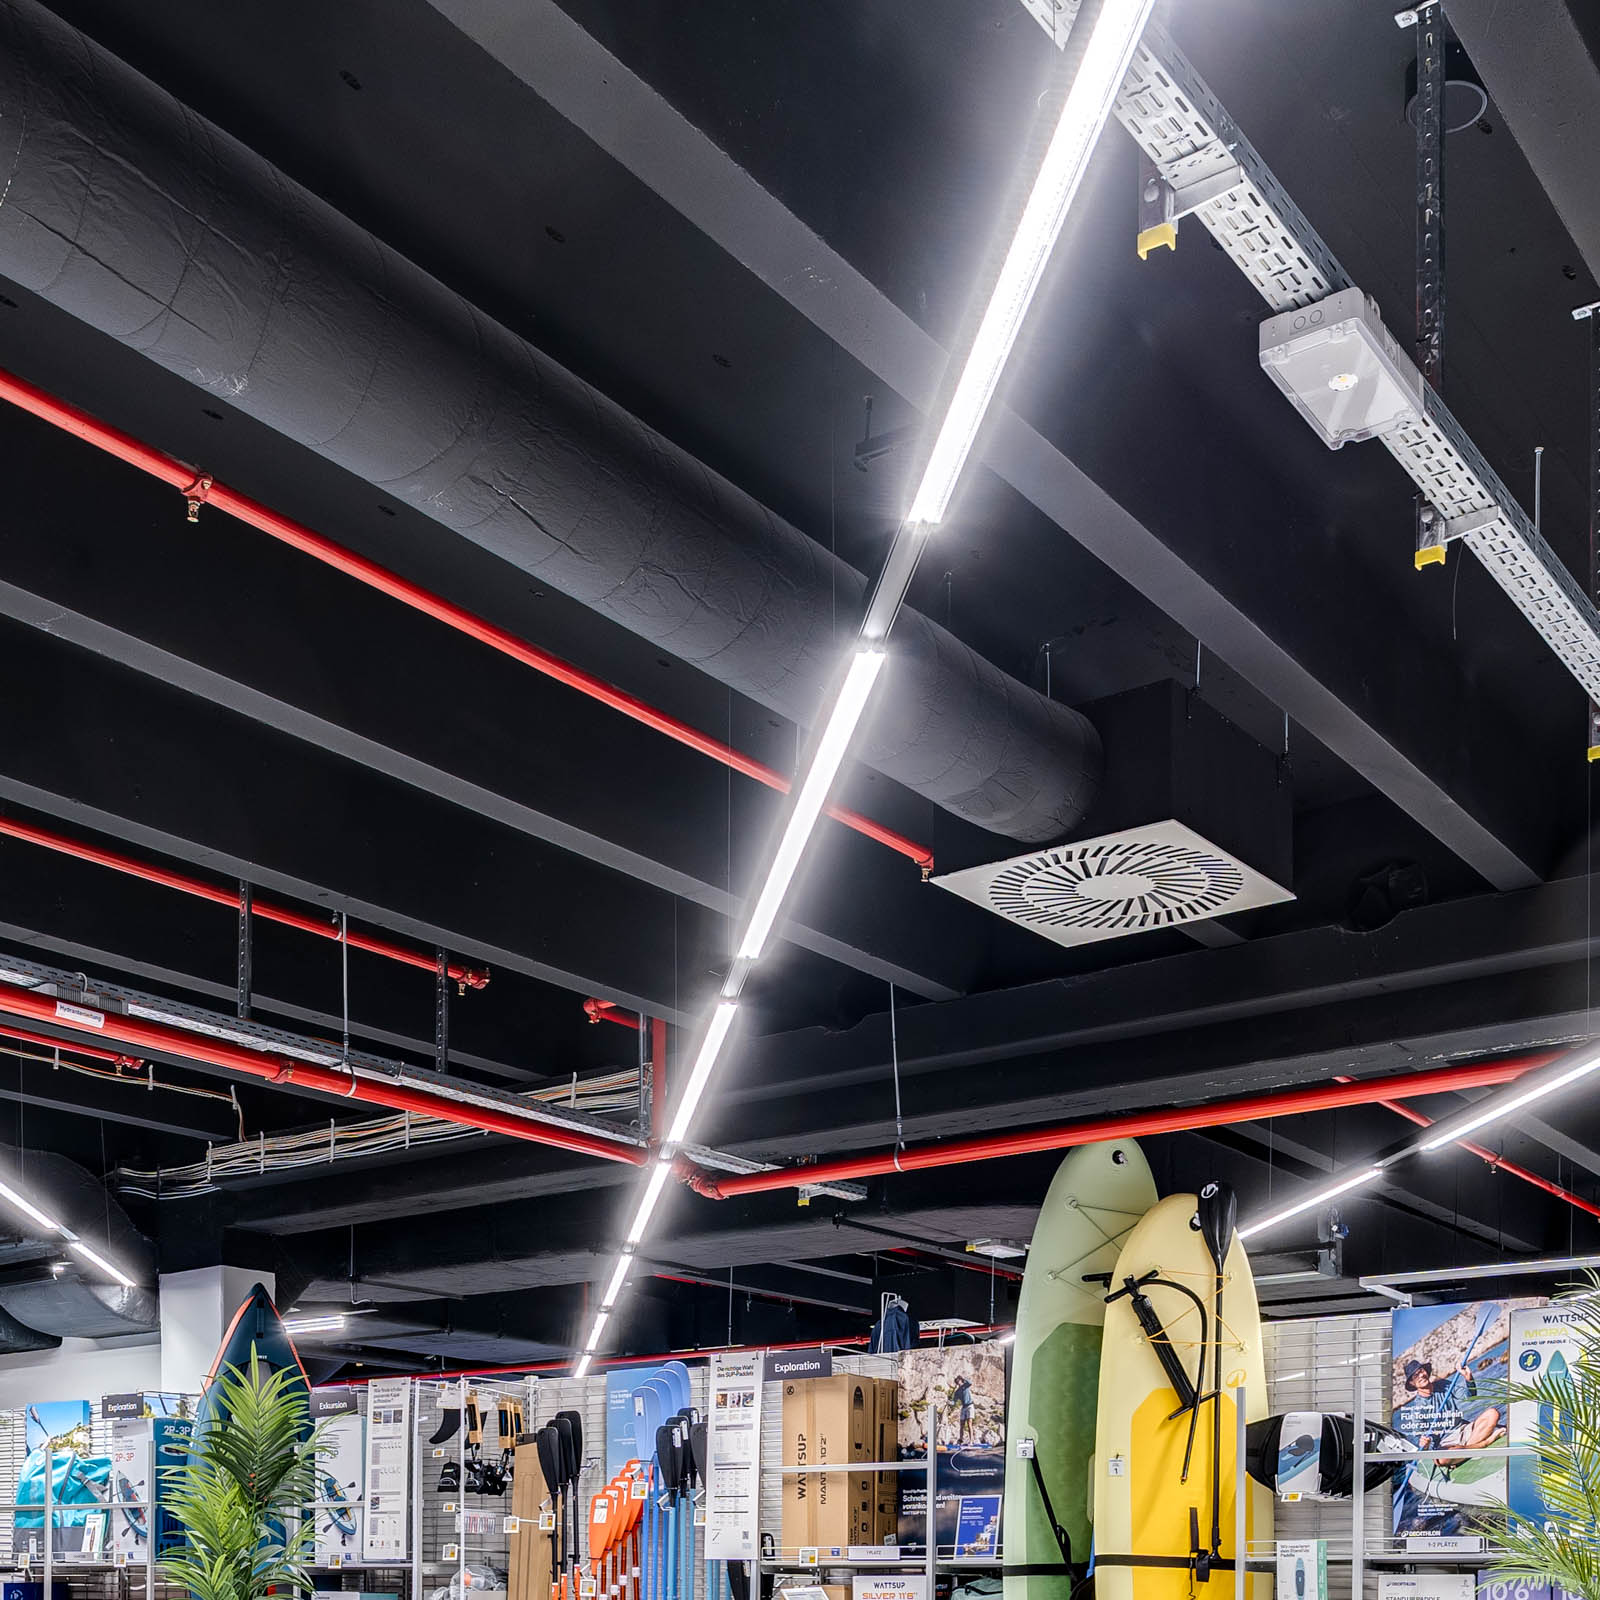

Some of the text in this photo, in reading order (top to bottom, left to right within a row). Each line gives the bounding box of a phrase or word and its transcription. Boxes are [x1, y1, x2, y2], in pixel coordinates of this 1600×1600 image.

[774, 1360, 821, 1374] Exploration
[108, 1402, 137, 1413] Exploration
[319, 1401, 348, 1410] Exkursion
[1415, 1411, 1441, 1420] Touren
[1442, 1409, 1463, 1418] allein
[1431, 1419, 1455, 1428] zweit!
[862, 1592, 896, 1600] SILVER
